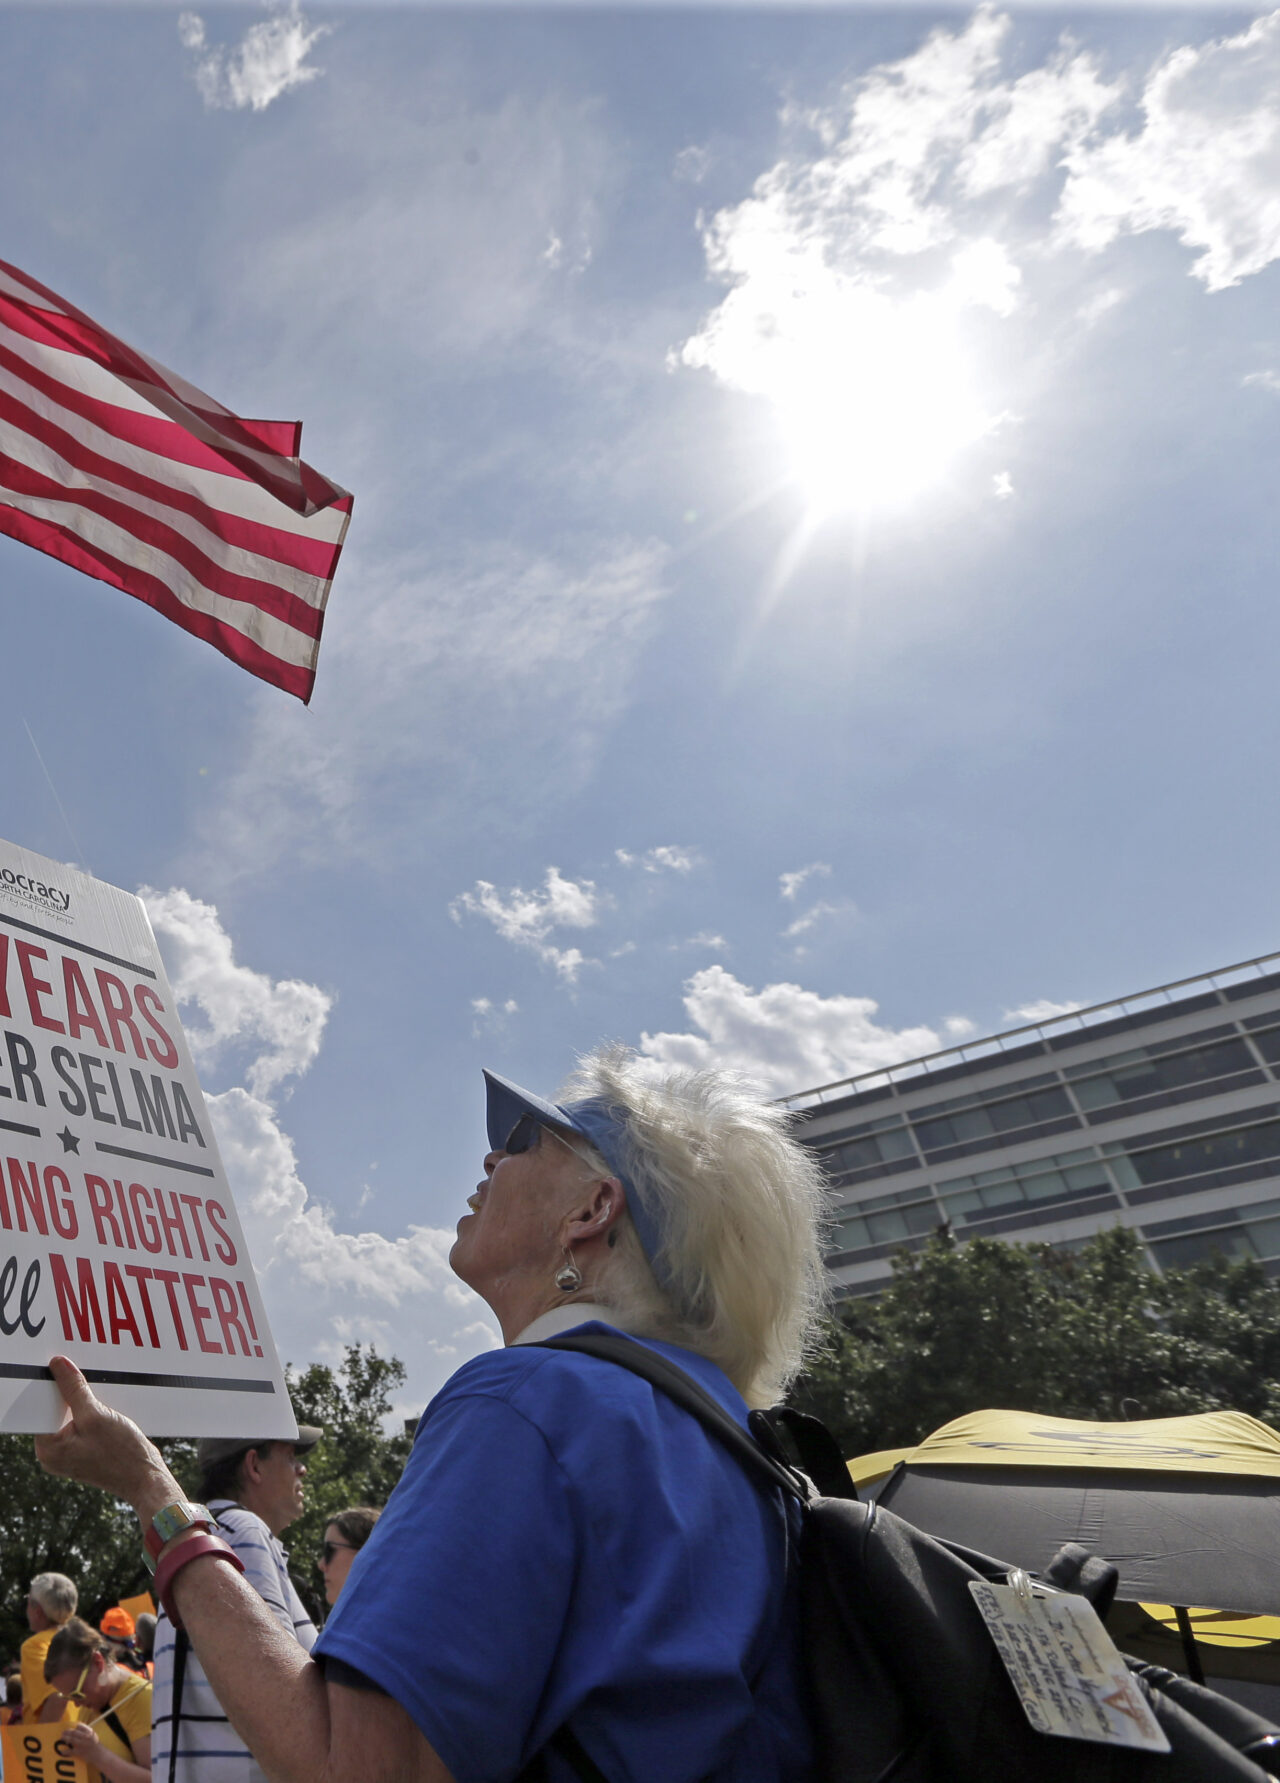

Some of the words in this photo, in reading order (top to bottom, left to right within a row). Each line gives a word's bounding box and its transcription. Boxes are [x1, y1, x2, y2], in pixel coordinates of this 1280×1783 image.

[22, 890, 66, 913] CAROLINA
[50, 1045, 207, 1148] SELMA
[83, 1172, 238, 1266] RIGHTS
[48, 1252, 264, 1358] MATTER!
[54, 1740, 76, 1783] OU
